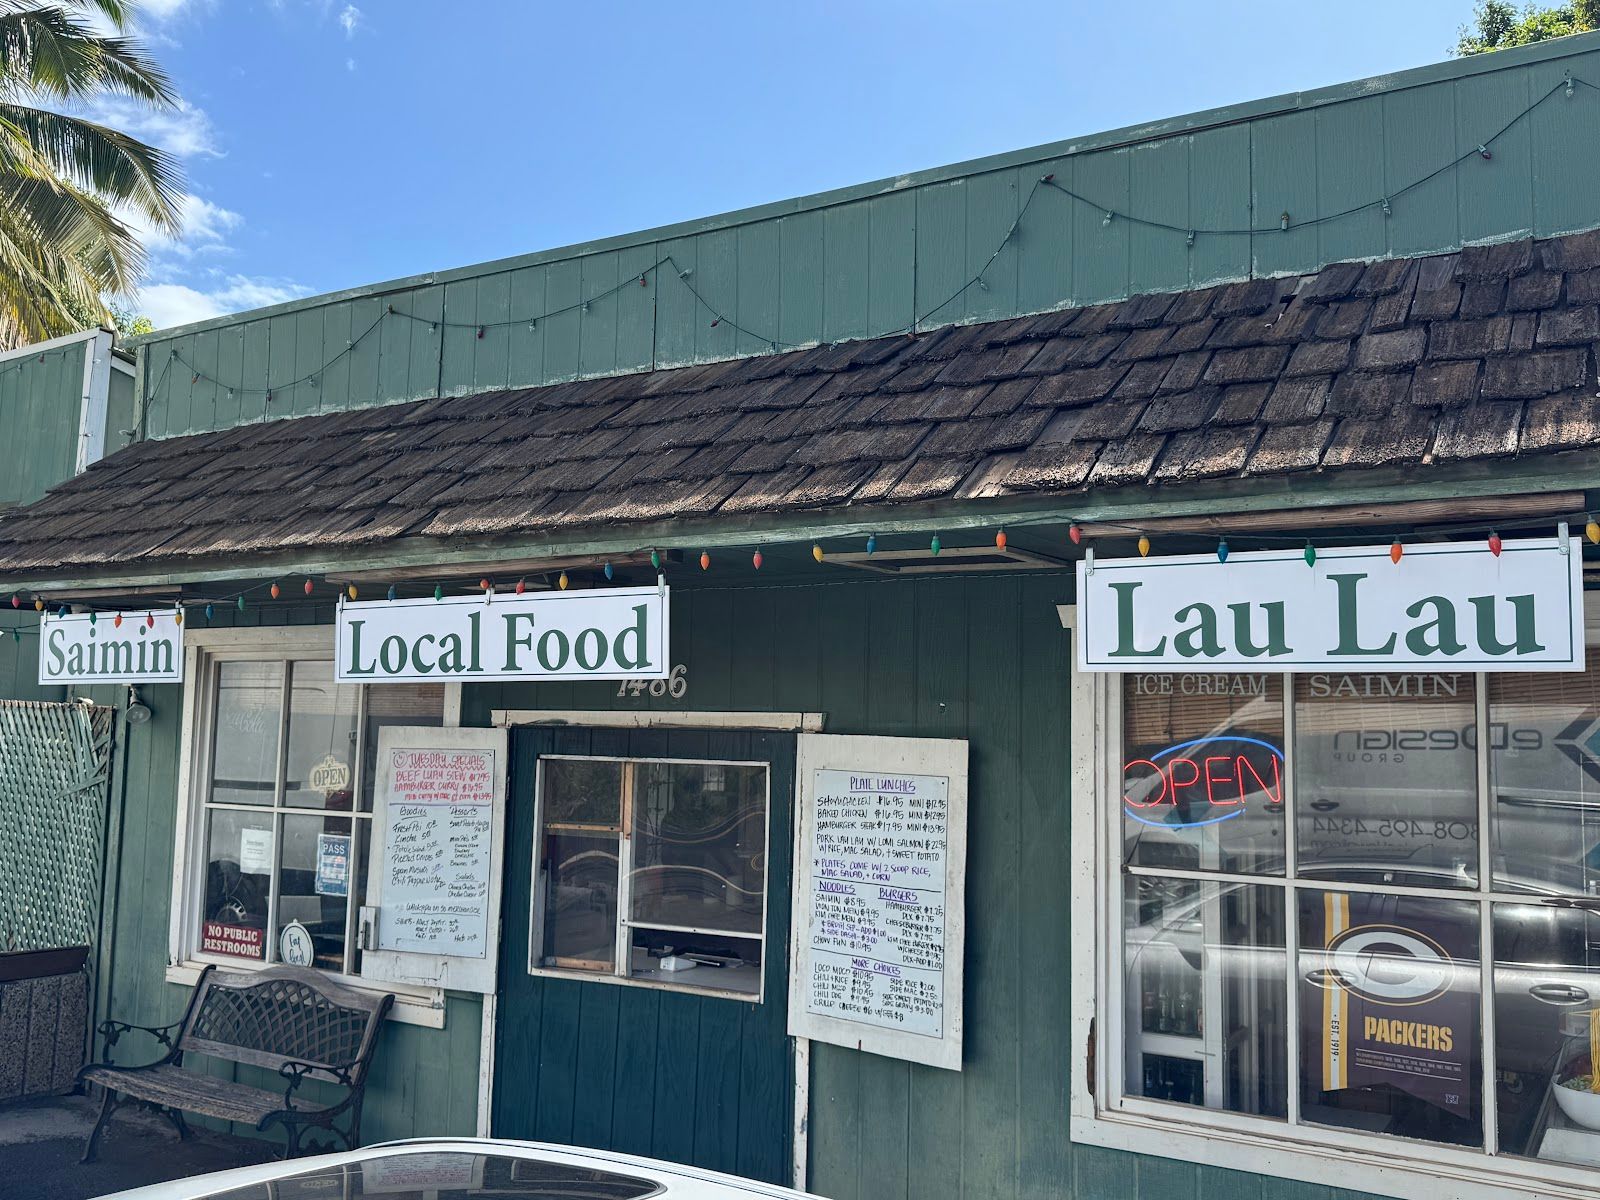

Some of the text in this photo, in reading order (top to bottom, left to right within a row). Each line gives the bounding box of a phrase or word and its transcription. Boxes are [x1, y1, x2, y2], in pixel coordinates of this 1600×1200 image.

[1107, 572, 1546, 658] Lau Lau
[346, 604, 652, 675] Local Food
[47, 626, 175, 676] Saimin
[1135, 674, 1268, 696] ICE CREAM
[1310, 674, 1461, 697] SAIMIN
[408, 752, 446, 767] TUESDAY
[313, 768, 347, 786] OPEN
[396, 770, 420, 782] BEEF
[877, 777, 916, 792] LUNCHES
[1124, 755, 1282, 807] OPEN
[909, 799, 924, 809] MINI
[908, 811, 923, 819] MINI
[817, 821, 857, 832] HAMBURGER
[906, 822, 922, 832] MINI
[323, 843, 345, 854] PASS
[816, 833, 835, 845] PORK
[897, 839, 924, 849] SALMON
[821, 859, 846, 869] PLATES
[819, 880, 856, 893] NOODLES
[880, 887, 918, 902] BURGERS
[208, 924, 258, 942] NO PUBLIC
[203, 940, 261, 958] RESTROOMS
[851, 957, 901, 976] MORE CHOICES
[1364, 1016, 1453, 1052] PACKERS
[1330, 1038, 1340, 1057] 1919
